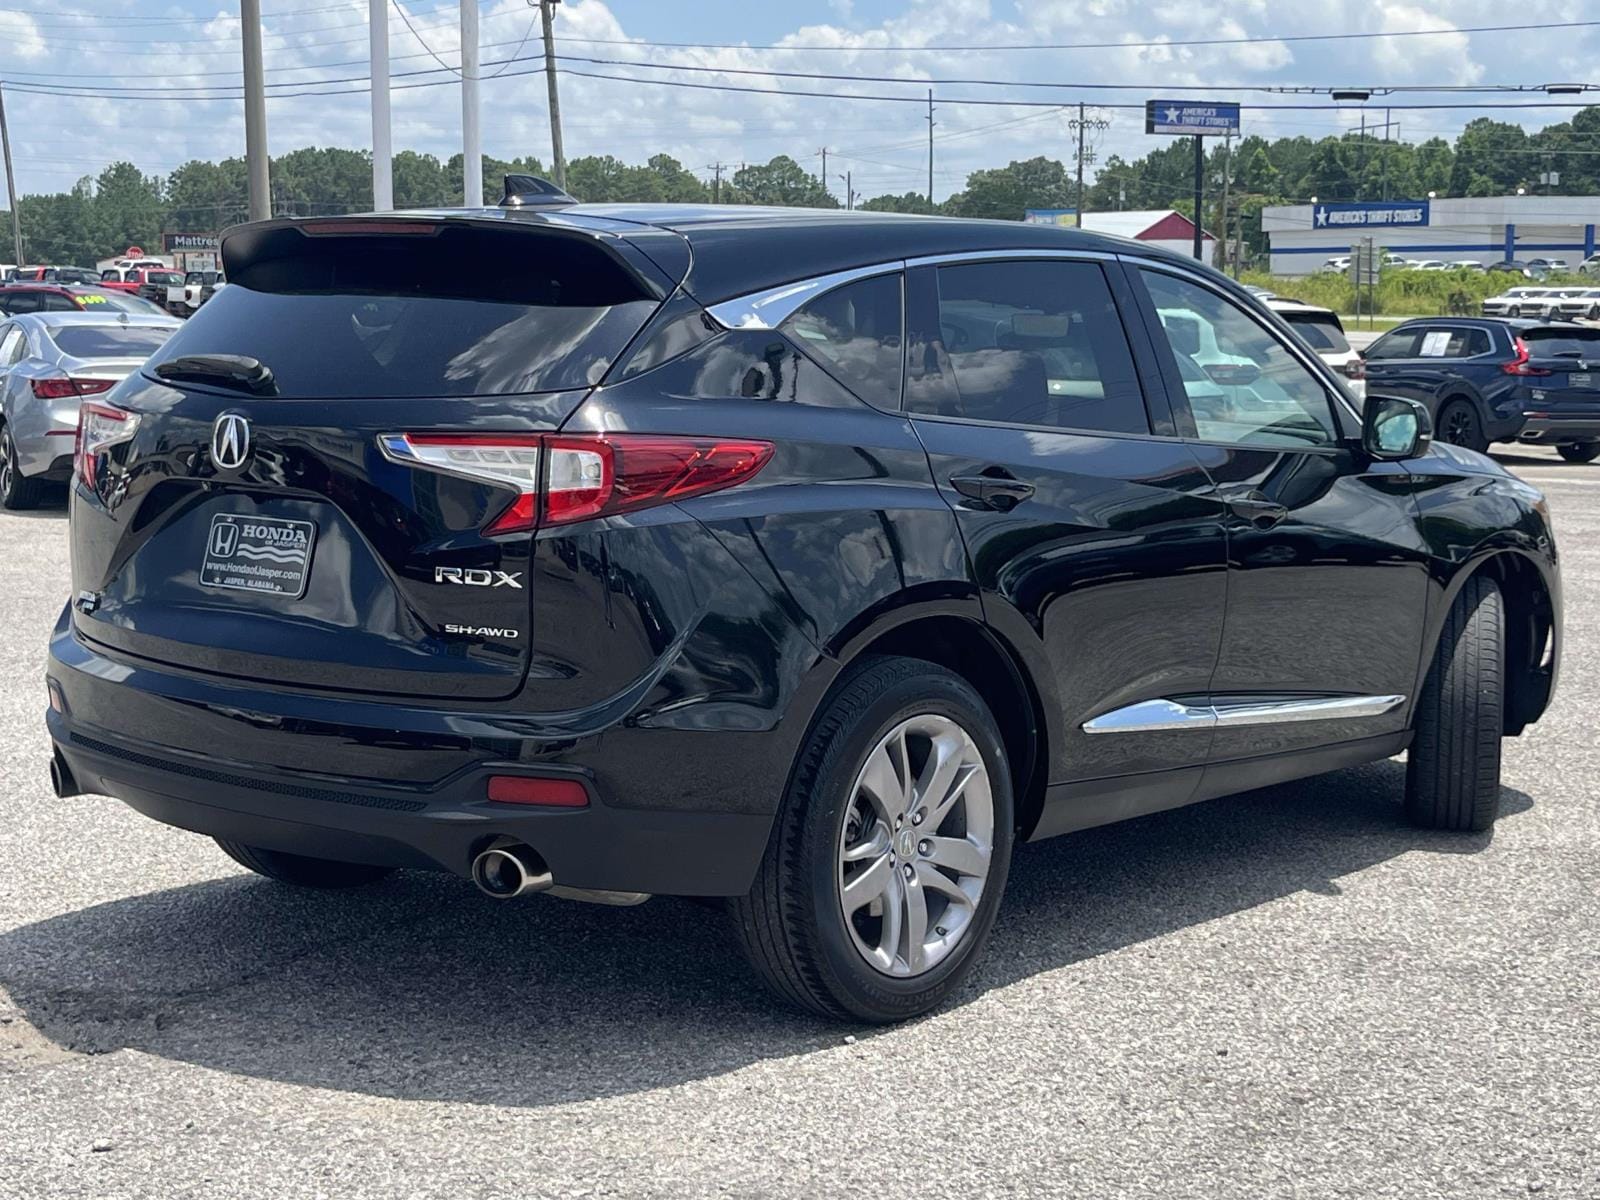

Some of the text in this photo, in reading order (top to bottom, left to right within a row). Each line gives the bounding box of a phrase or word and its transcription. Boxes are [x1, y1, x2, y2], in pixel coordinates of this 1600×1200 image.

[1182, 107, 1217, 117] AMERICA'S
[1182, 116, 1230, 126] THRIFT STORES
[1328, 208, 1423, 224] AMERICA'S THRIFT STORES
[242, 524, 307, 544] HONDA
[274, 540, 306, 549] JASPER
[206, 562, 301, 579] www.HondaofJasper.com
[247, 579, 275, 589] ALABAMA
[435, 566, 523, 589] RDX
